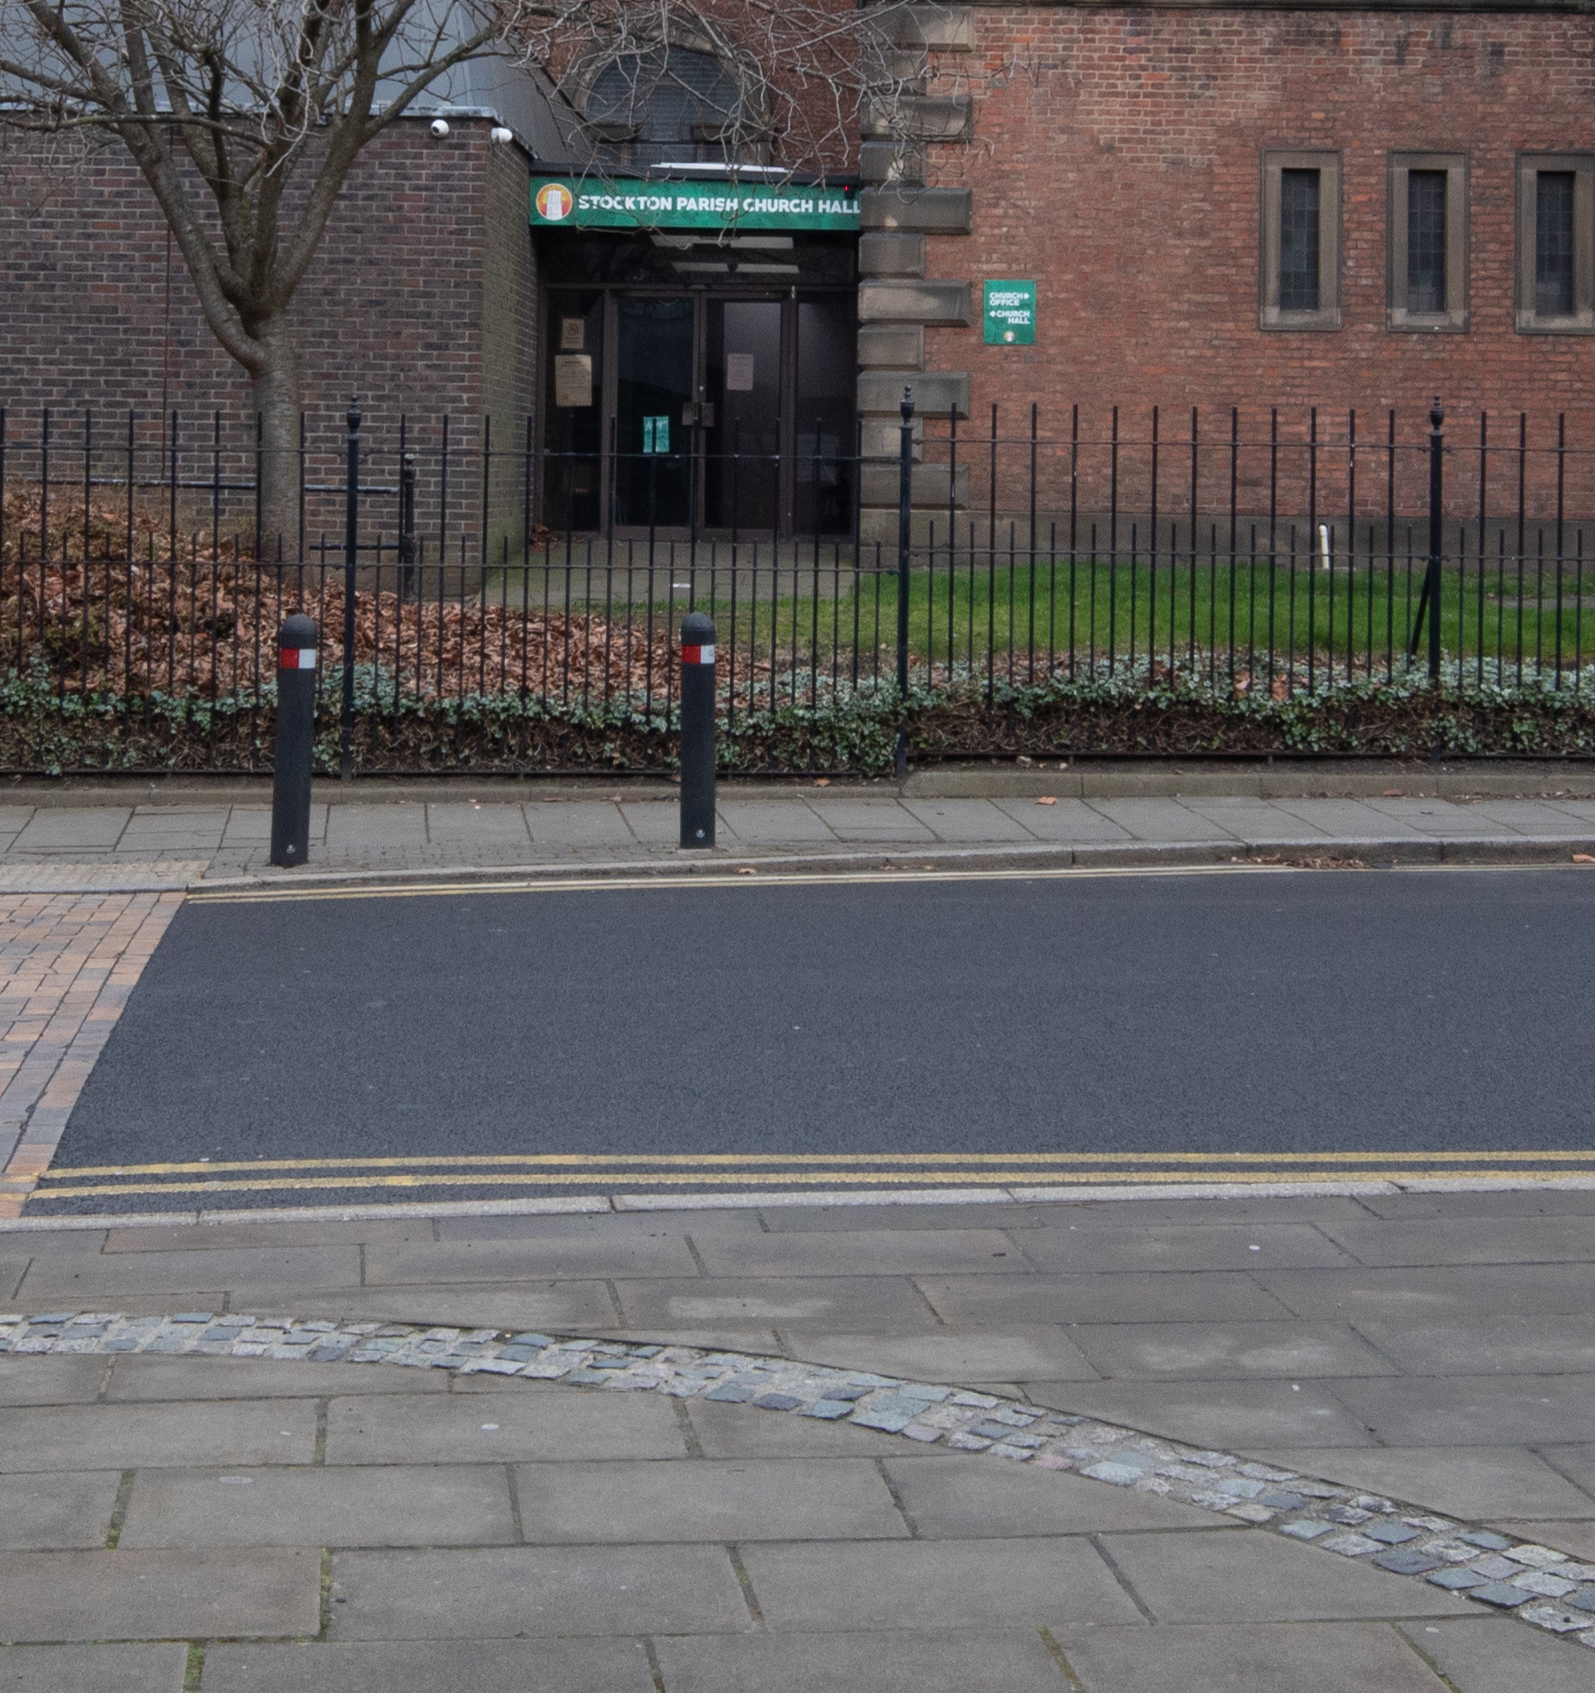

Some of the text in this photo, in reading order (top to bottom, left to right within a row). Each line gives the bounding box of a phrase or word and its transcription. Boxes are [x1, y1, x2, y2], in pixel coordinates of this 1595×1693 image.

[578, 195, 861, 214] STOCKTON PARISH CHURCH HALL
